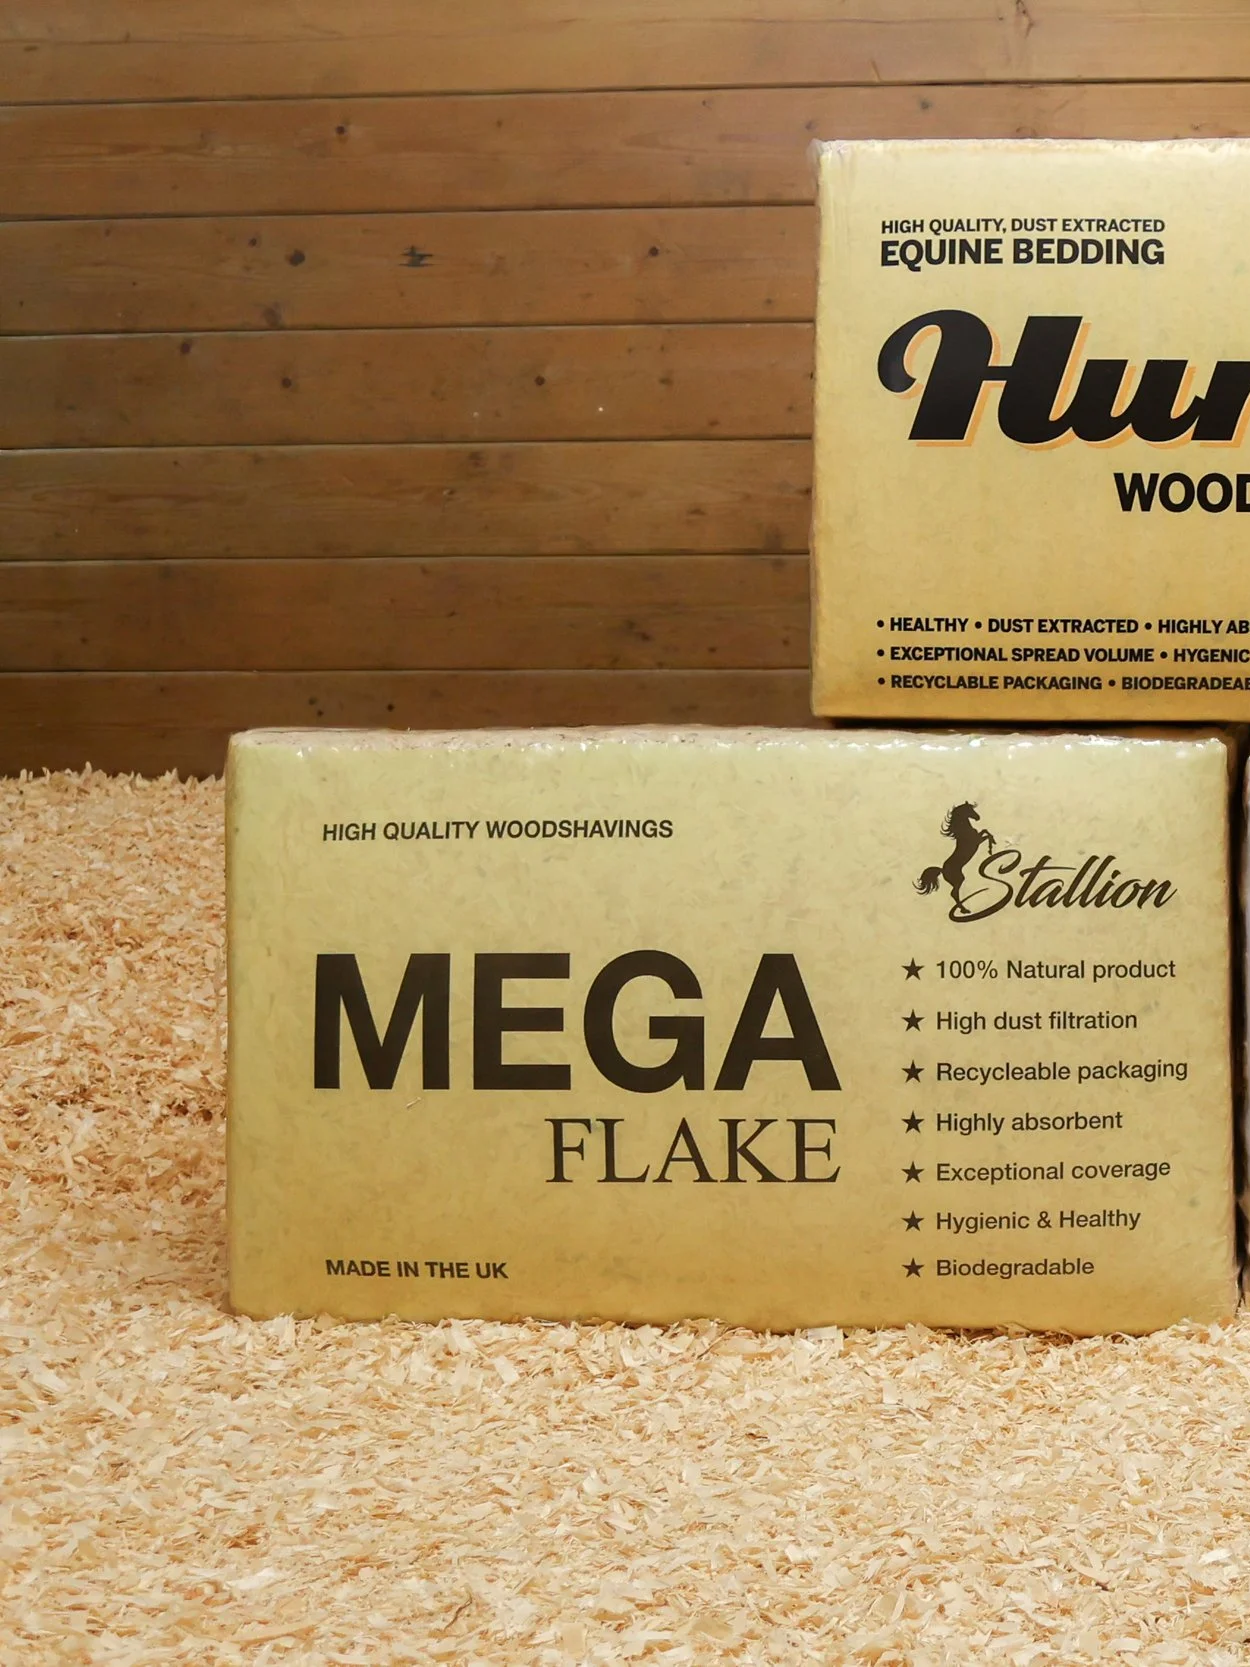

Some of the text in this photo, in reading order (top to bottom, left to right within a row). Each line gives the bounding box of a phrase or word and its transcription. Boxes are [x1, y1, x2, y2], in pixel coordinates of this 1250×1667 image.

[881, 218, 1166, 236] HIGH QUALITY, DUST EXTRACTED
[880, 238, 1165, 273] EQUINE BEDDING
[890, 616, 969, 633] HEALTHY
[988, 618, 1035, 633] DUST
[1037, 618, 1139, 634] EXTRACTED
[1158, 619, 1224, 635] HIGHLY
[890, 646, 1009, 662] EXCEPTIONAL
[1011, 647, 1081, 662] SPREAD
[1083, 647, 1155, 663] VOLUME
[1173, 648, 1250, 664] HYGENIC
[890, 674, 1000, 690] RECYCLABLE
[1003, 675, 1103, 690] PACKAGING
[322, 819, 674, 842] HIGH QUALITY WOODSHAVINGS
[948, 849, 1177, 923] Stallion
[936, 959, 1176, 983] 100% Natural product
[313, 949, 842, 1094] MEGA
[936, 1010, 1137, 1035] High dust filtration
[936, 1059, 1188, 1086] Recycleable packaging
[936, 1111, 1123, 1136] Highly absorbent
[544, 1117, 841, 1183] FLAKE
[936, 1161, 1171, 1186] Exceptional coverage
[936, 1208, 1141, 1235] Hygienic & Healthy
[325, 1259, 509, 1279] MADE IN THE UK
[936, 1257, 1095, 1280] Biodegradable
